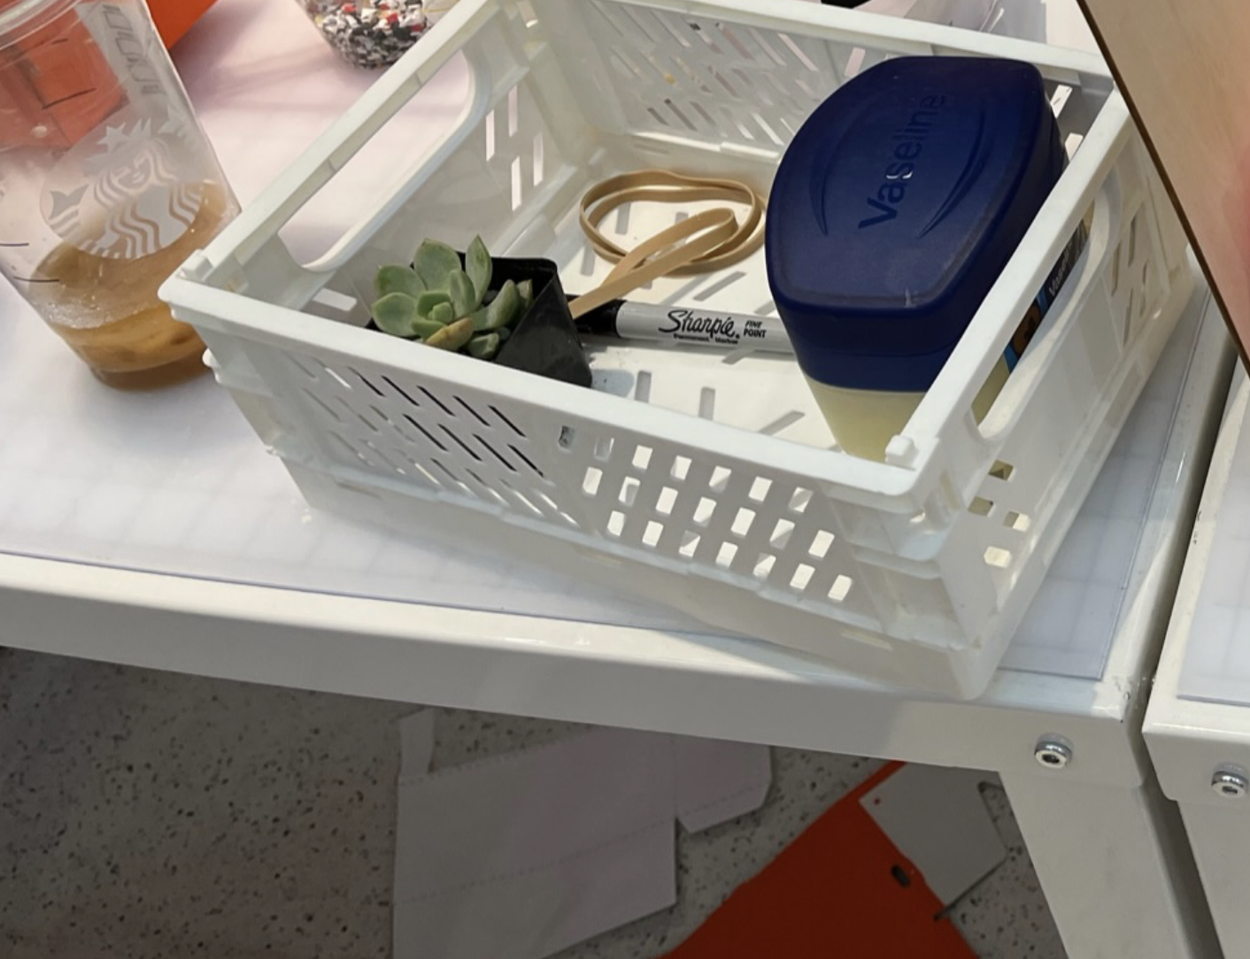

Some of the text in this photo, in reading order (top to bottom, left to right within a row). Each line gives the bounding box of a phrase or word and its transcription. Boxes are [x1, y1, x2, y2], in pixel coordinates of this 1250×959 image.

[857, 94, 948, 230] Vaseline
[744, 320, 763, 329] FINE
[743, 328, 767, 339] POINT
